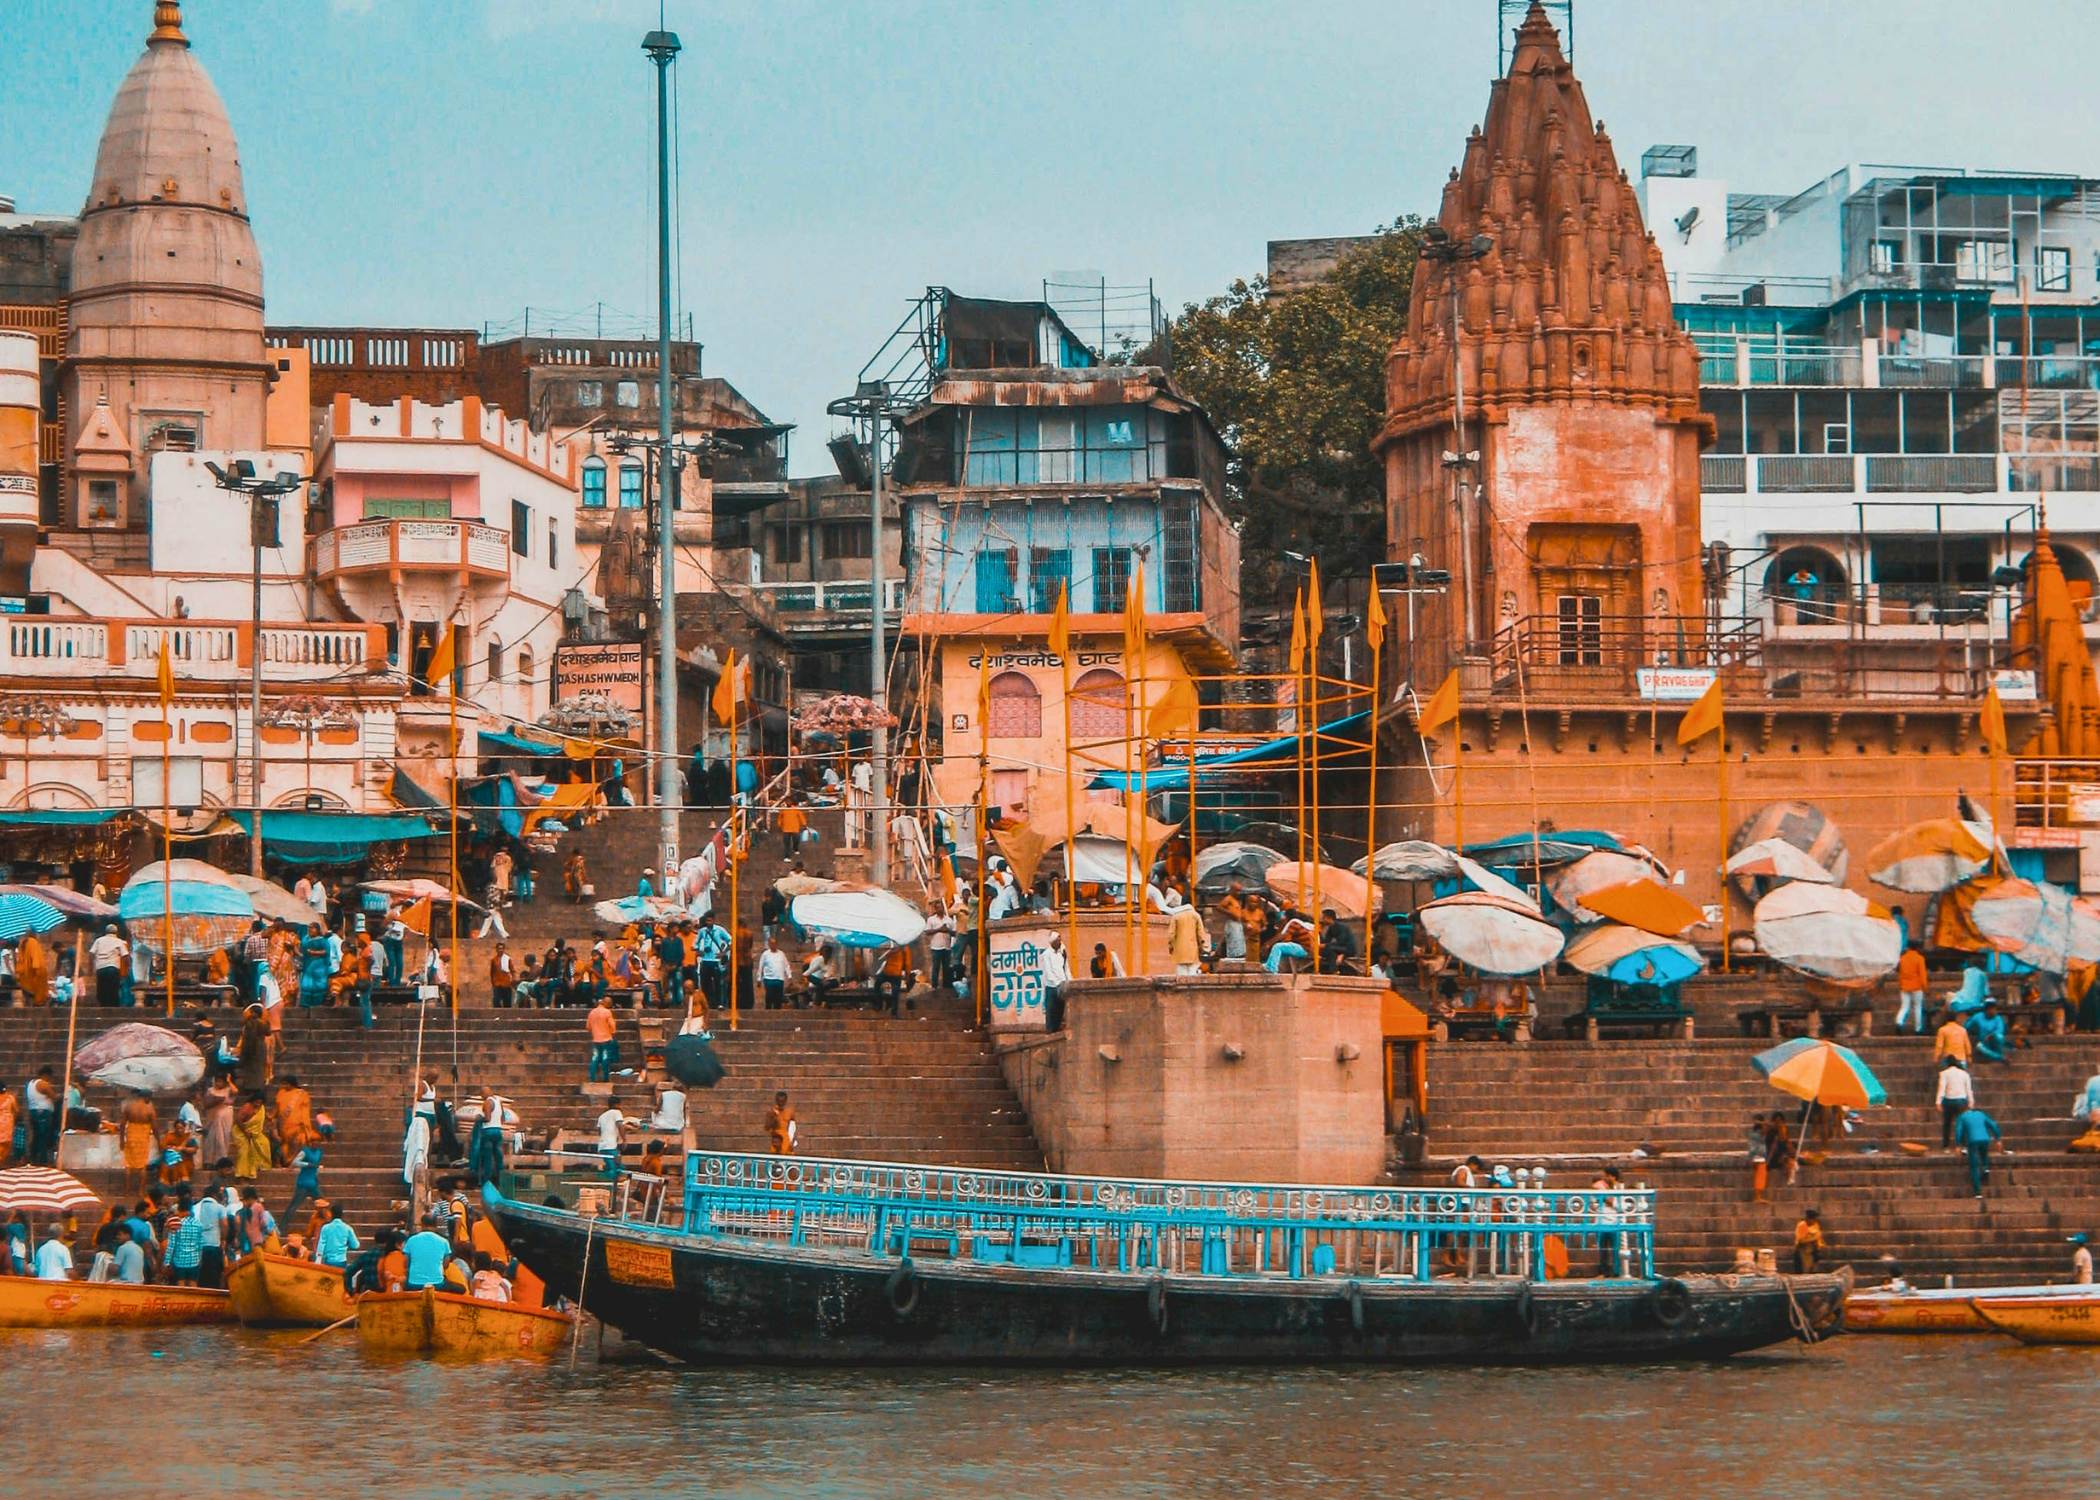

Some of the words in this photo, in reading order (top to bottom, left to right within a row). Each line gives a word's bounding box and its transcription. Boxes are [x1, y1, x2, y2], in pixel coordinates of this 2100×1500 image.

[620, 652, 640, 663] घाट
[1077, 652, 1124, 667] घाट
[558, 673, 639, 684] DASHASHWMEDH
[991, 940, 1038, 969] नमामि
